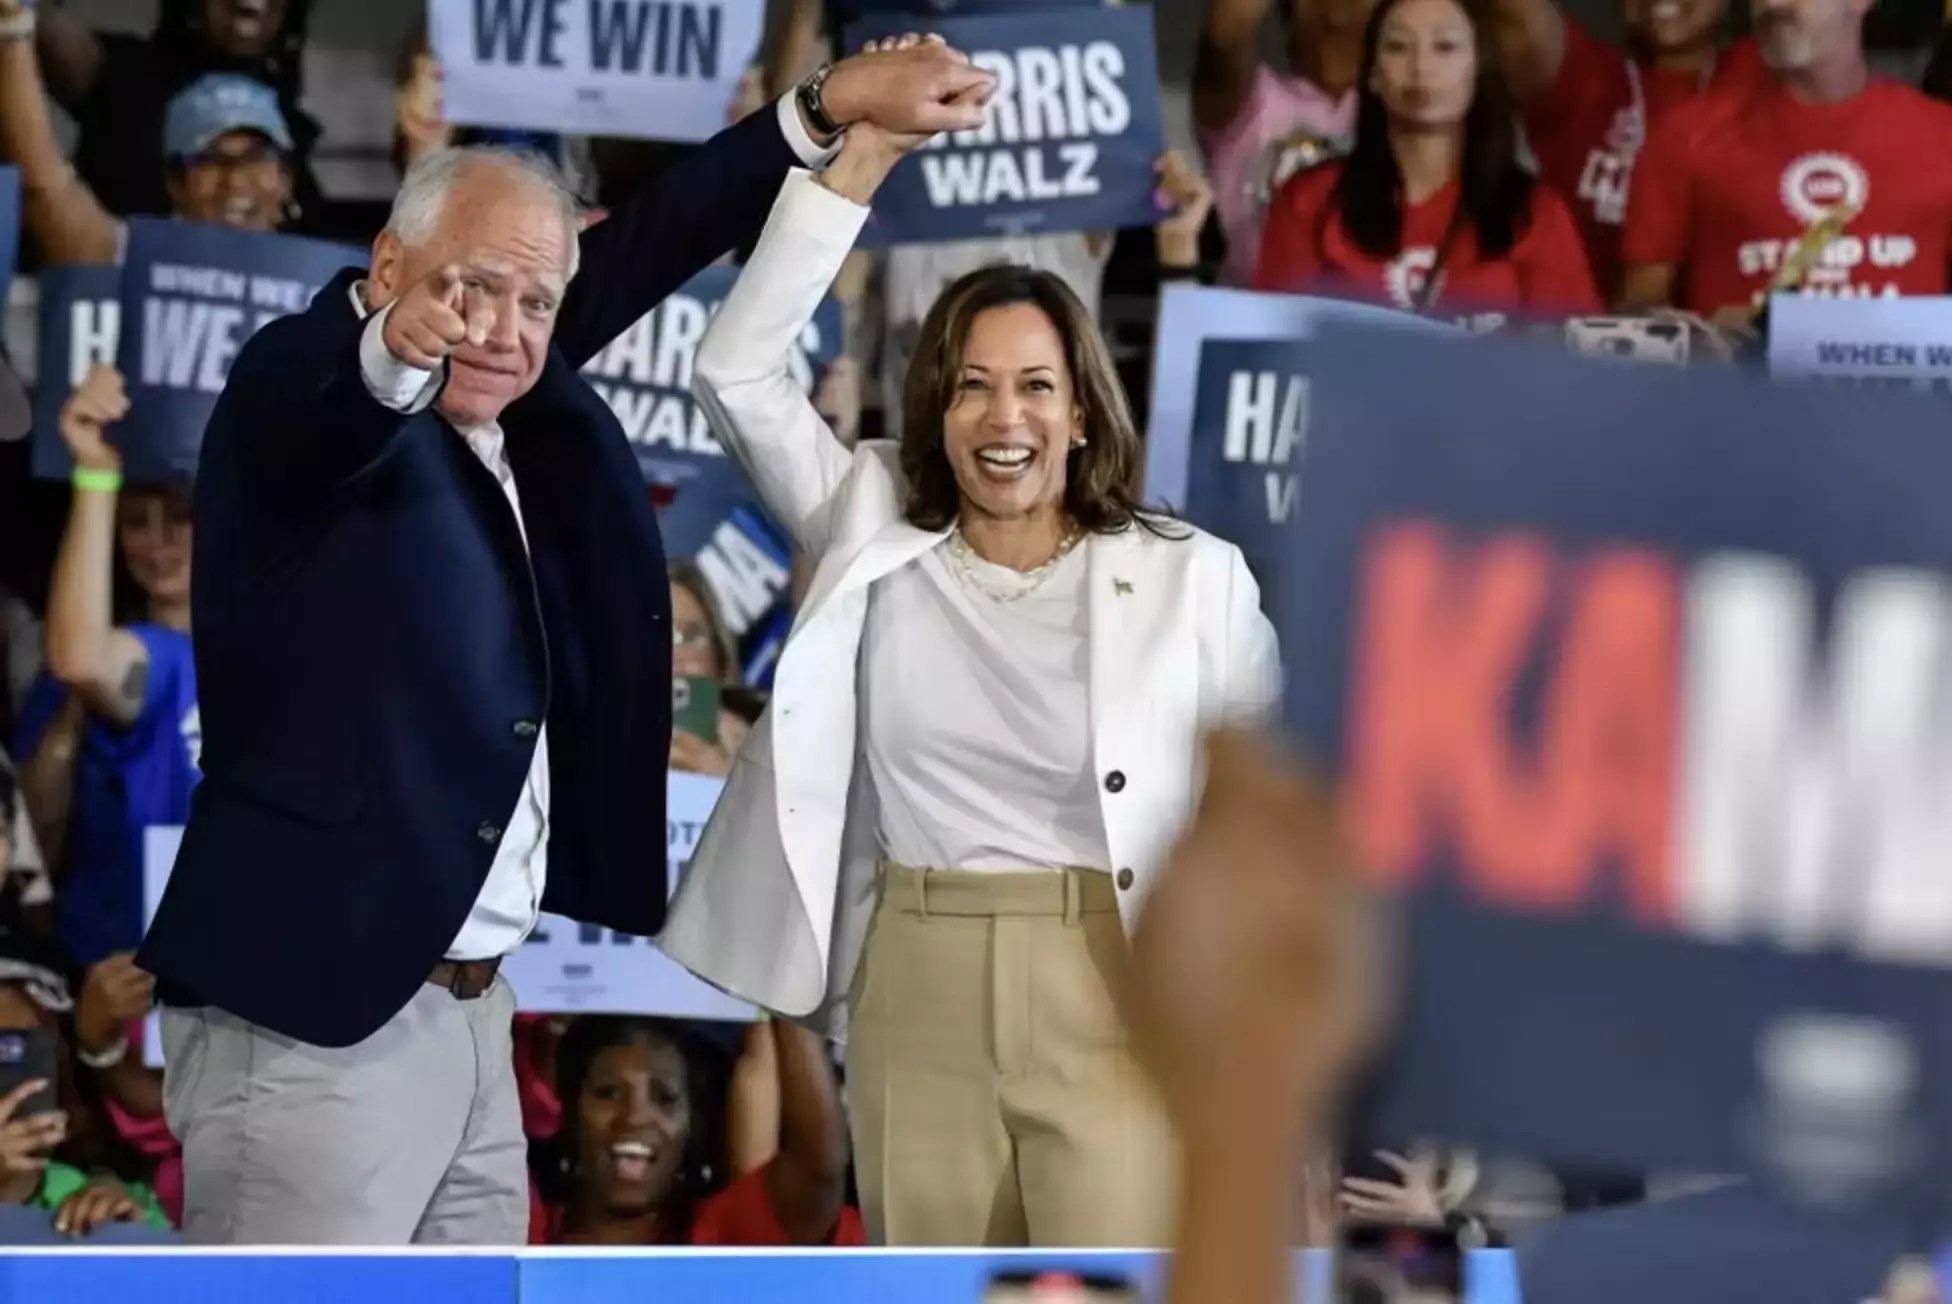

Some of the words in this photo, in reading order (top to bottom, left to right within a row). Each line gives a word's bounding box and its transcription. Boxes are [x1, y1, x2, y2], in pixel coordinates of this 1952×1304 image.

[472, 0, 566, 68] WE
[588, 0, 722, 80] WIN
[923, 41, 1131, 148] RRIS
[920, 143, 1100, 207] WALZ
[1817, 342, 1915, 366] WHEN
[595, 382, 728, 457] WAL
